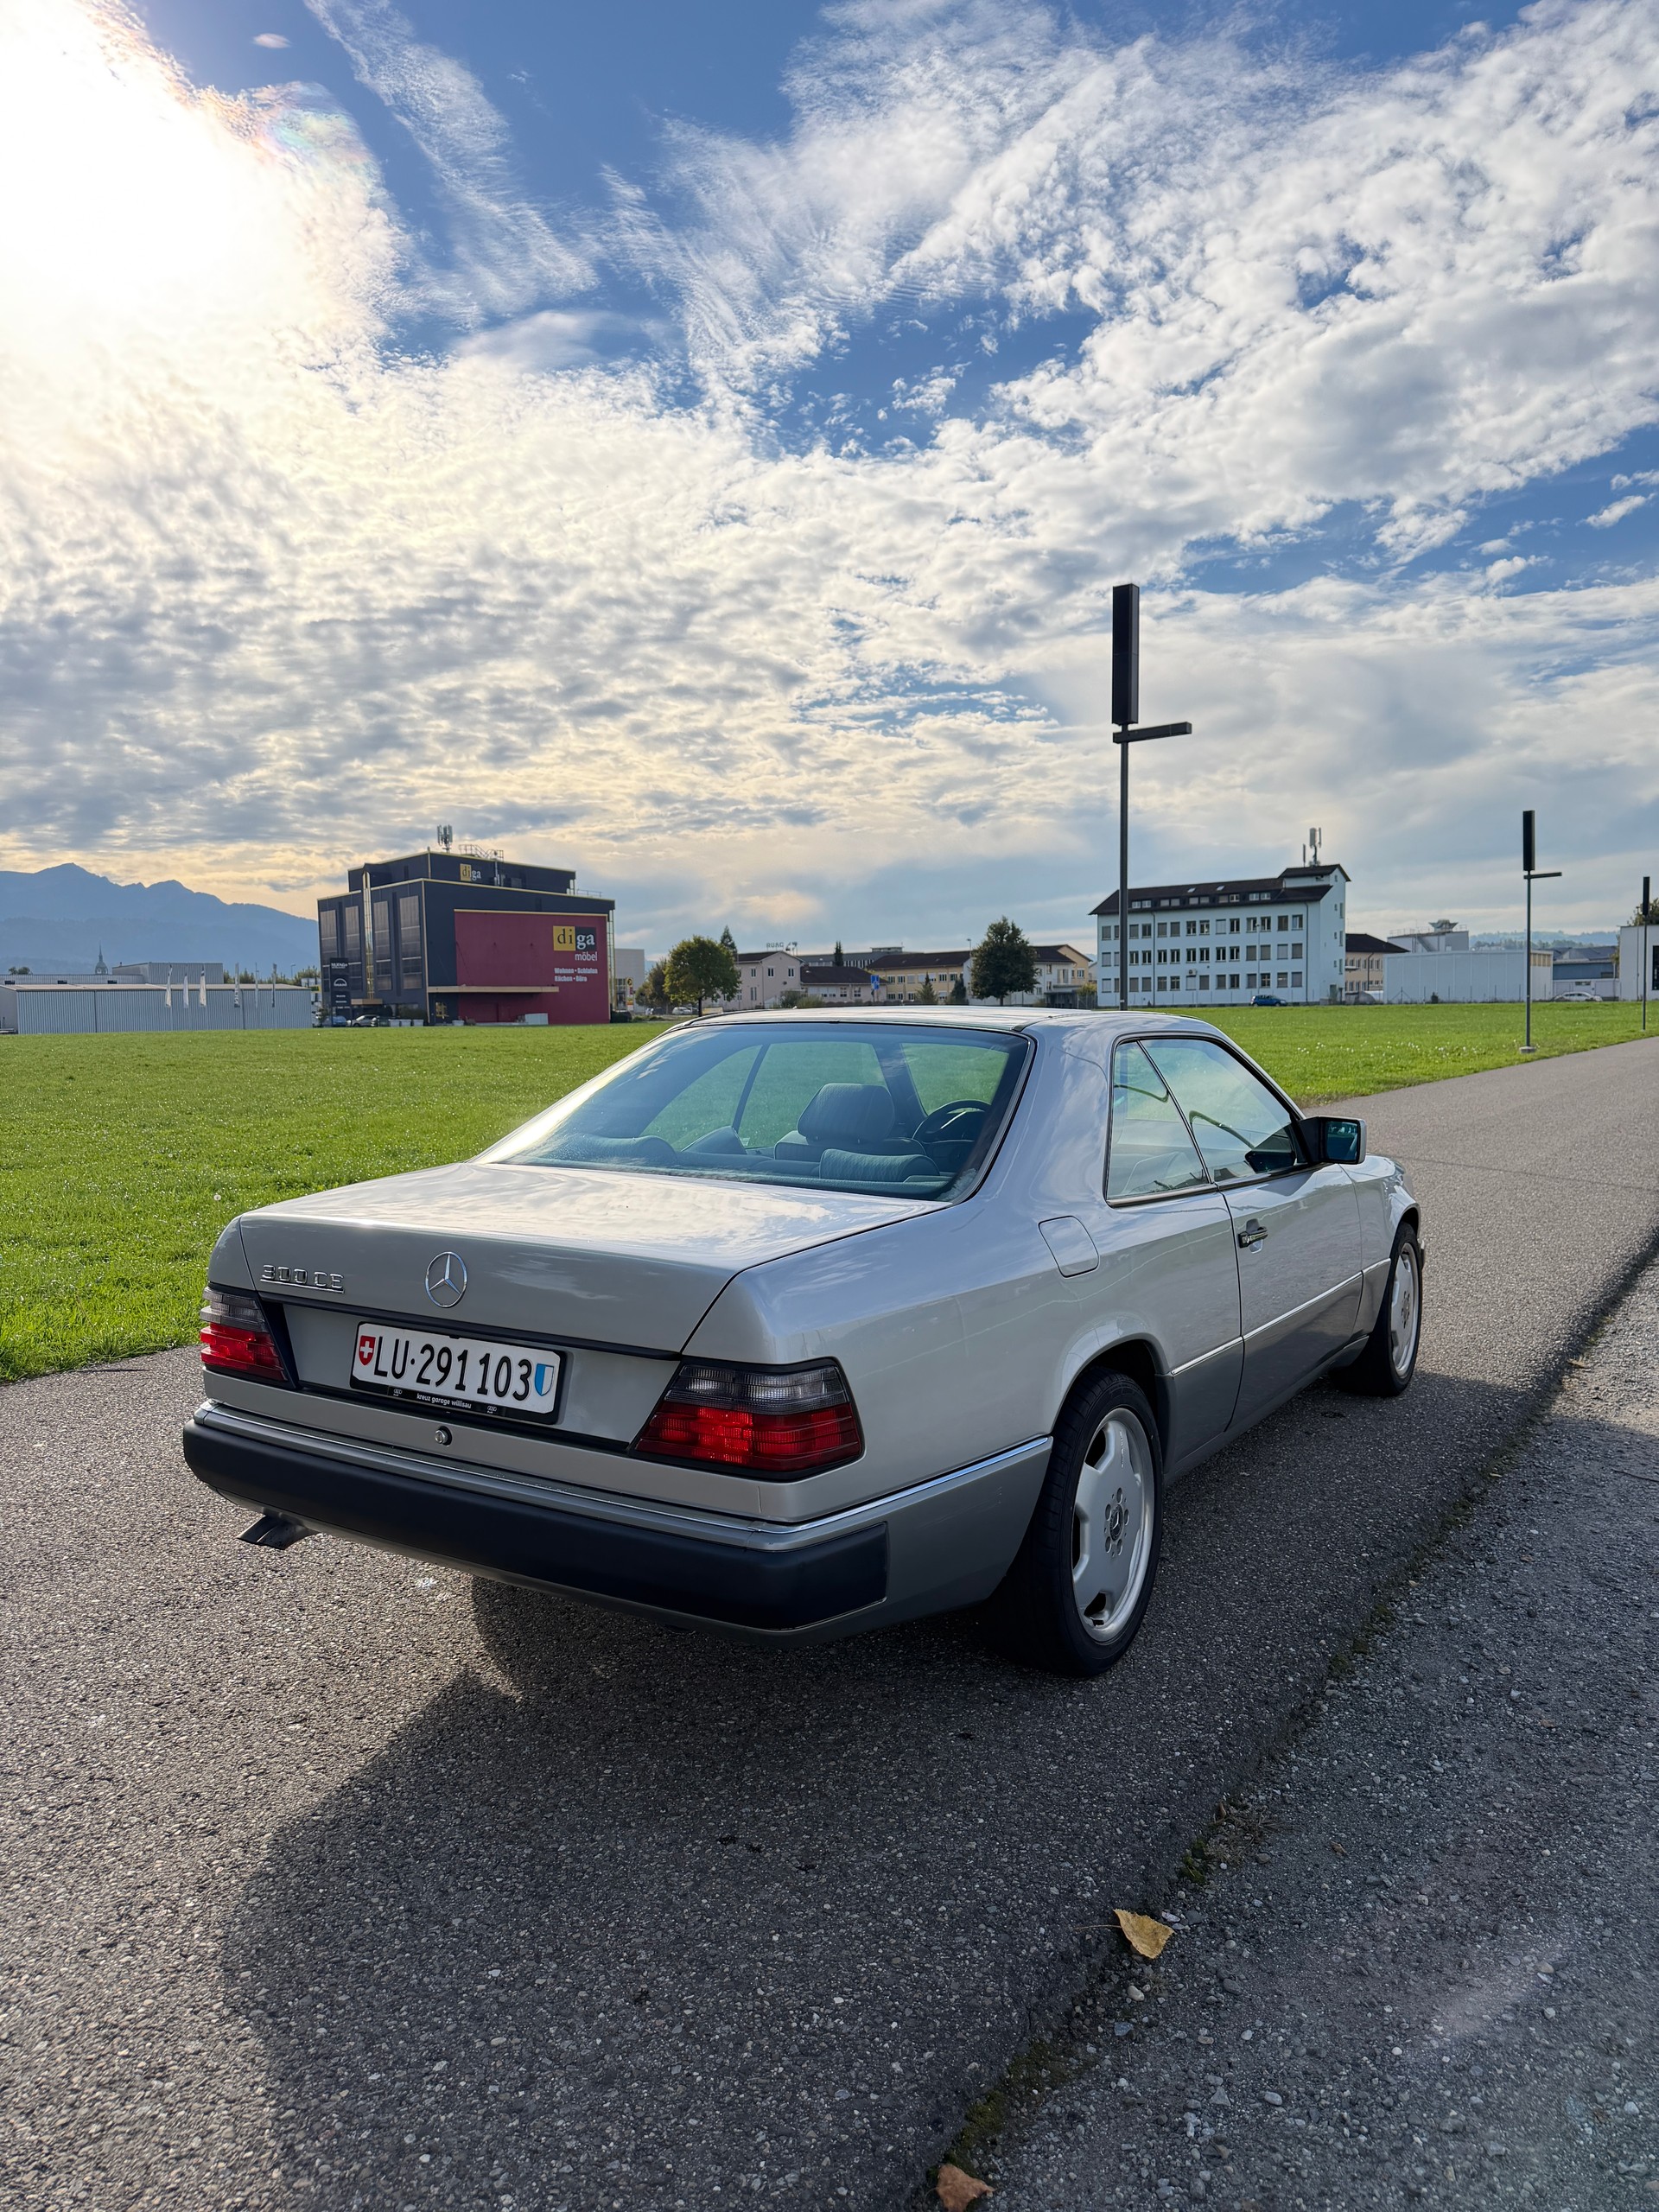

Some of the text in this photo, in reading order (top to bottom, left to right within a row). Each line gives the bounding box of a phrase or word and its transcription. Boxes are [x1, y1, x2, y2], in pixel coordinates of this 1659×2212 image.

[462, 865, 481, 881] diga
[557, 928, 595, 950] diga
[575, 951, 598, 961] möbel
[261, 1264, 344, 1288] 300 CE
[416, 1393, 472, 1409] kreuz garage willisau
